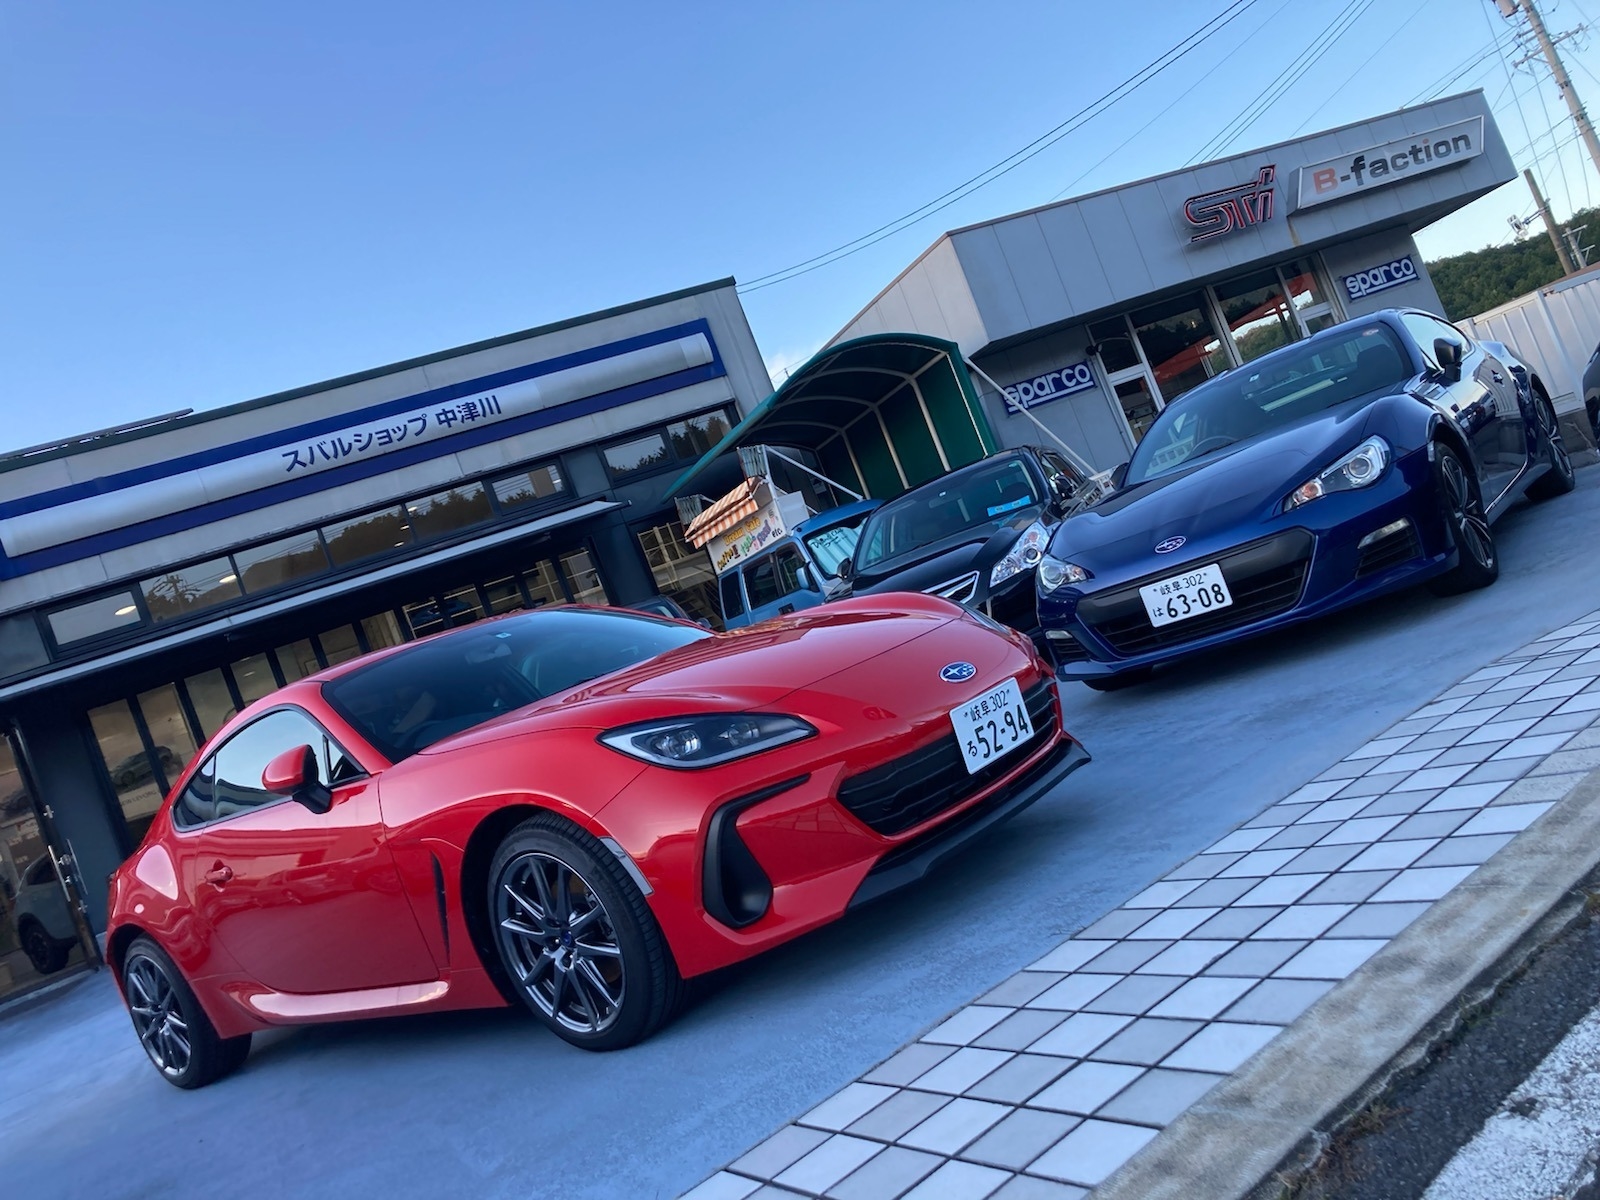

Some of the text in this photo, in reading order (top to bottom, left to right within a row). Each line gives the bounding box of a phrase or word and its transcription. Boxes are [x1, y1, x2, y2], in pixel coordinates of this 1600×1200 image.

[1312, 133, 1471, 195] B-faction
[1345, 258, 1414, 295] sparco
[1003, 364, 1091, 409] sparco
[281, 395, 502, 472] スバルショップ 中津川
[1167, 583, 1225, 618] 63-08
[1183, 573, 1204, 589] 302
[989, 690, 1008, 712] 302
[974, 705, 1029, 758] 52-94
